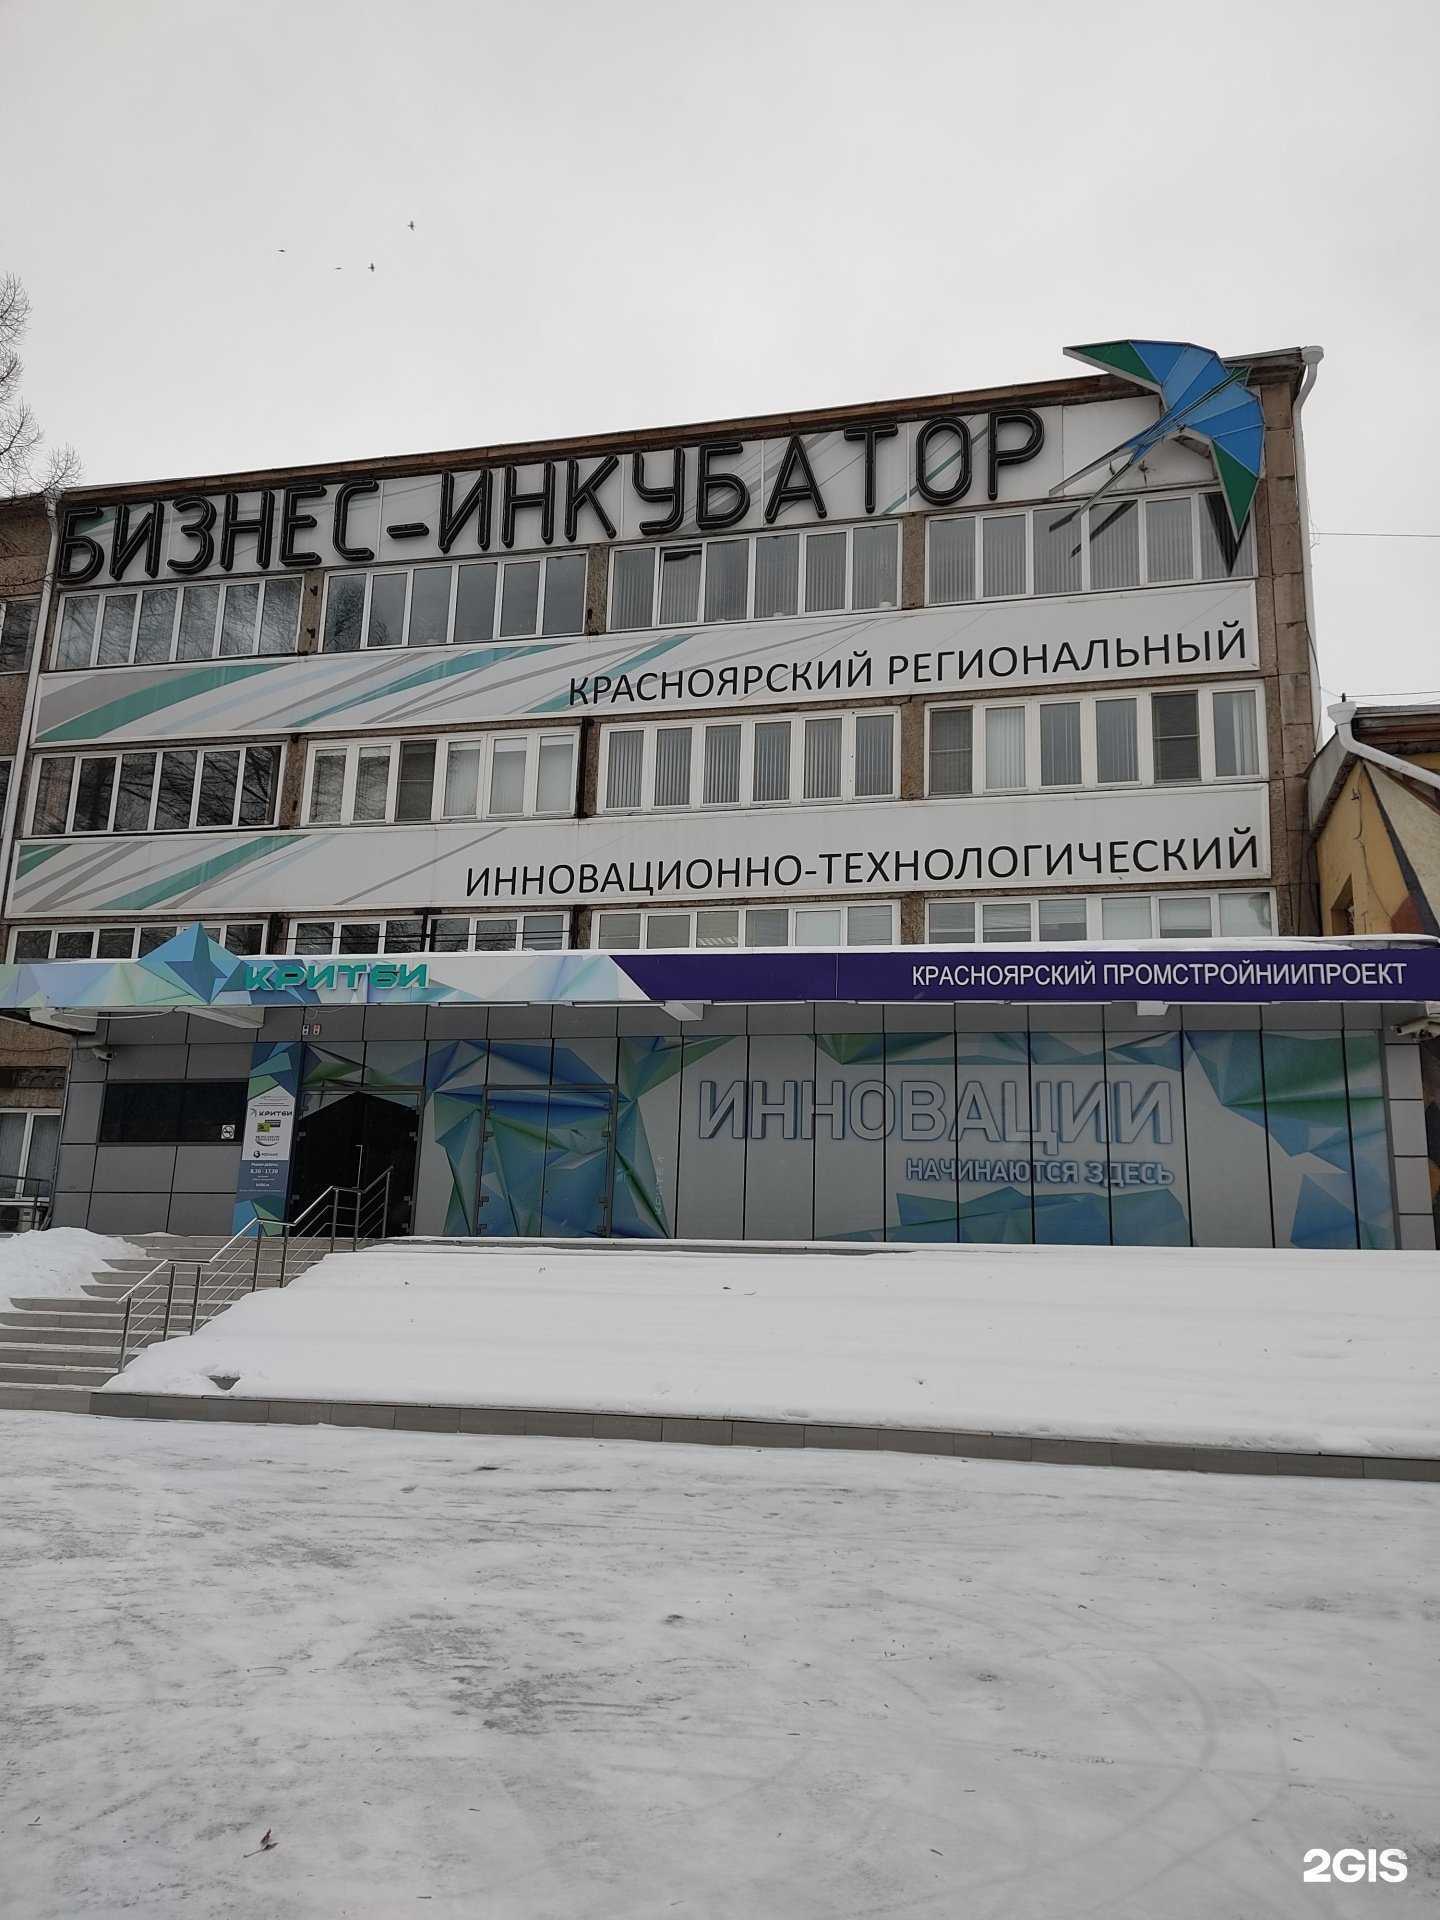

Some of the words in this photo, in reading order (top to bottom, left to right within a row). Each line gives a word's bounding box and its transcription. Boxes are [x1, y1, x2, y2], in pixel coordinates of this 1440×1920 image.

[58, 407, 1044, 584] БИЗНЕС-ИНКУБАТОР
[569, 651, 874, 706] КРАСНОЯРСКИЙ
[888, 620, 1248, 685] РЕГИОНАЛЬНЫЙ
[467, 827, 1258, 898] ИННОВАЦИОННО-ТЕХНОЛОГИЧЕСКИЙ
[245, 963, 429, 990] КРИТБИ
[912, 960, 1097, 986] КРАСНОЯРСКИЙ
[1103, 960, 1407, 986] ПРОМСТРОЙНИИПРОЕКТ
[699, 1080, 1174, 1156] ИННОВАЦИИ
[906, 1158, 1080, 1183] НАЧИНАЮТСЯ
[1084, 1162, 1175, 1188] ЗДЕСЬ
